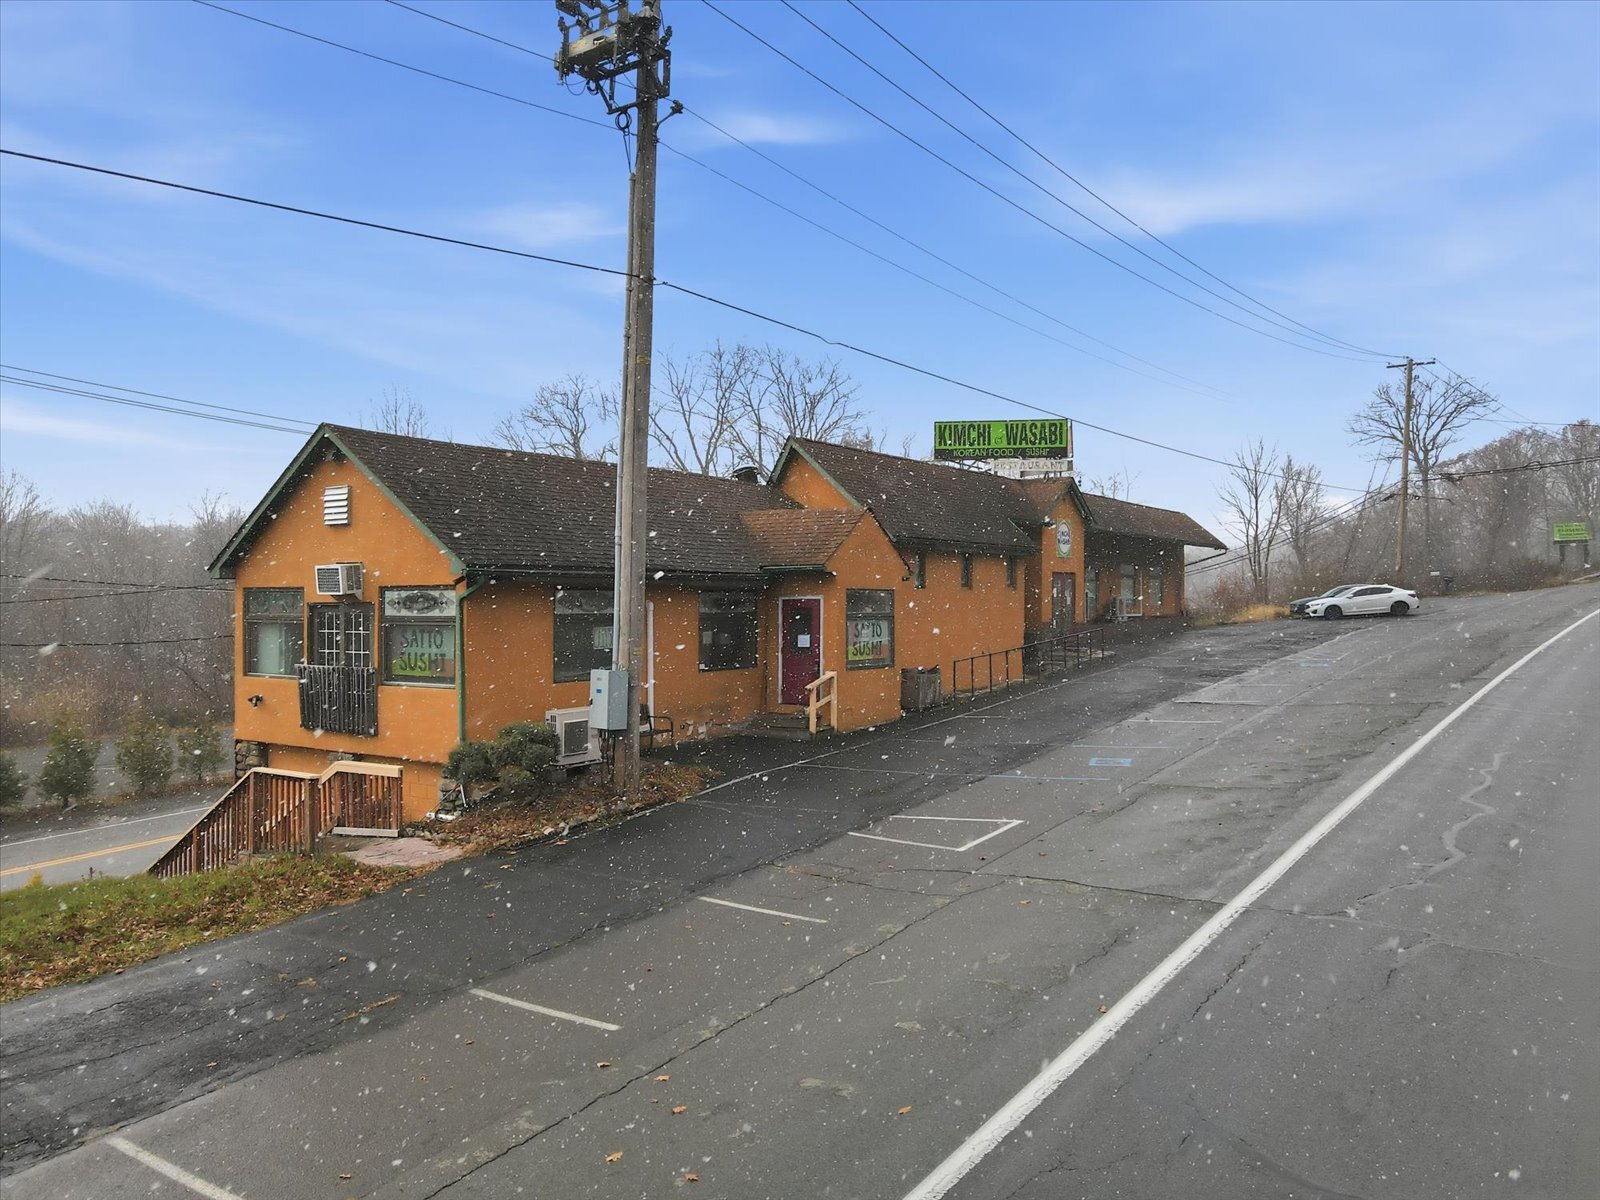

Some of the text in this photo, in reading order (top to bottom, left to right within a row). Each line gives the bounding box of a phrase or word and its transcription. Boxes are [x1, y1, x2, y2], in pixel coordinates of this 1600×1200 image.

[938, 423, 992, 447] KIMCHI
[1005, 422, 1063, 446] WASABI
[953, 448, 987, 457] KOREAN
[988, 448, 1014, 456] FOOD
[1025, 448, 1050, 456] SUSHI
[852, 640, 882, 656] SUSHI
[399, 652, 446, 672] SUSHI
